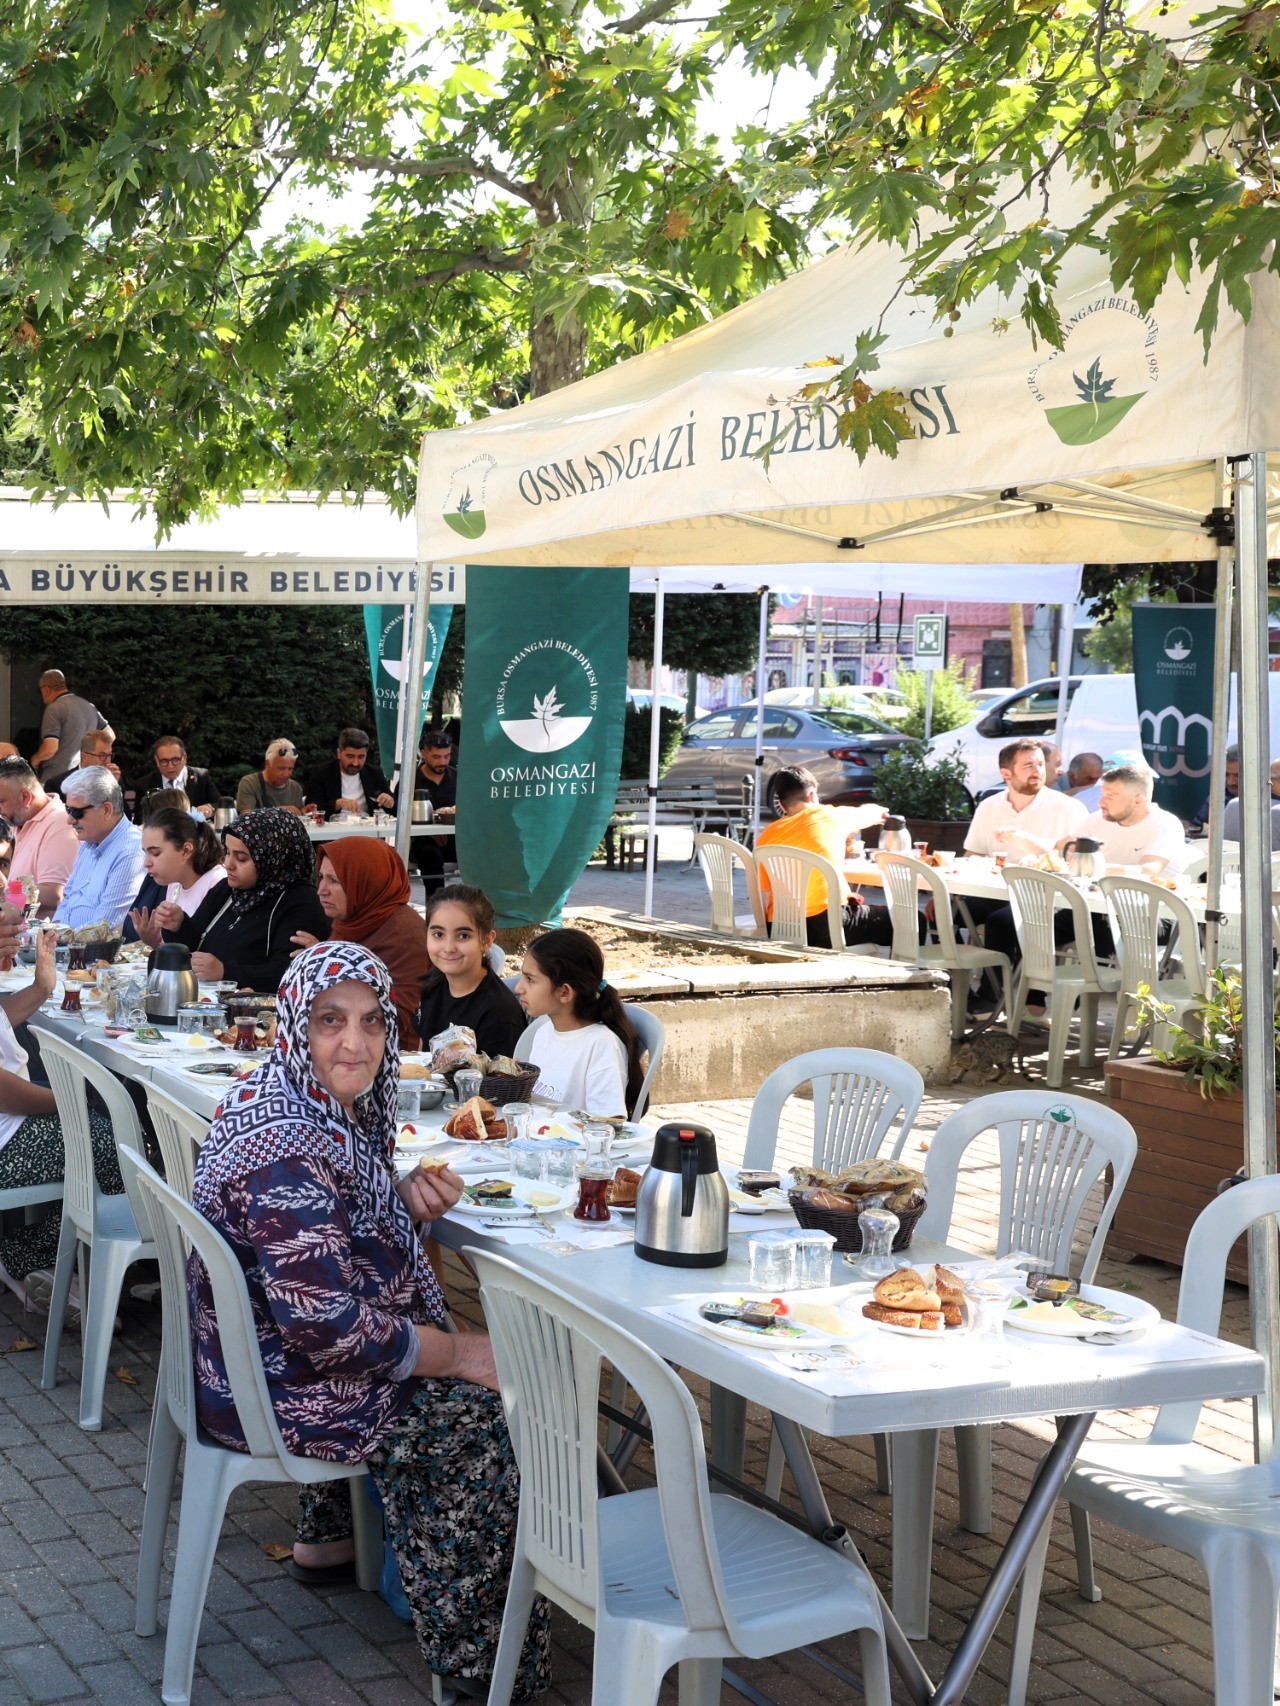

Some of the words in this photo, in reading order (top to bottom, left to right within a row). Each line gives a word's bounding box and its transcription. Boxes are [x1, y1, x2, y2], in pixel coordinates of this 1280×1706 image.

[1145, 351, 1159, 382] 1987
[519, 410, 697, 506] OSMANGAZİ
[720, 380, 961, 462] BELEDSİ
[31, 563, 249, 598] BÜYÜKŞEHİR
[496, 680, 508, 716] BURSA
[503, 637, 554, 678] OSMANGAZİ
[554, 639, 599, 688] BELEDİYESİ
[589, 690, 599, 711] 1987
[490, 761, 596, 783] OSMANGAZİ
[490, 780, 596, 799] BELEDİYESİ
